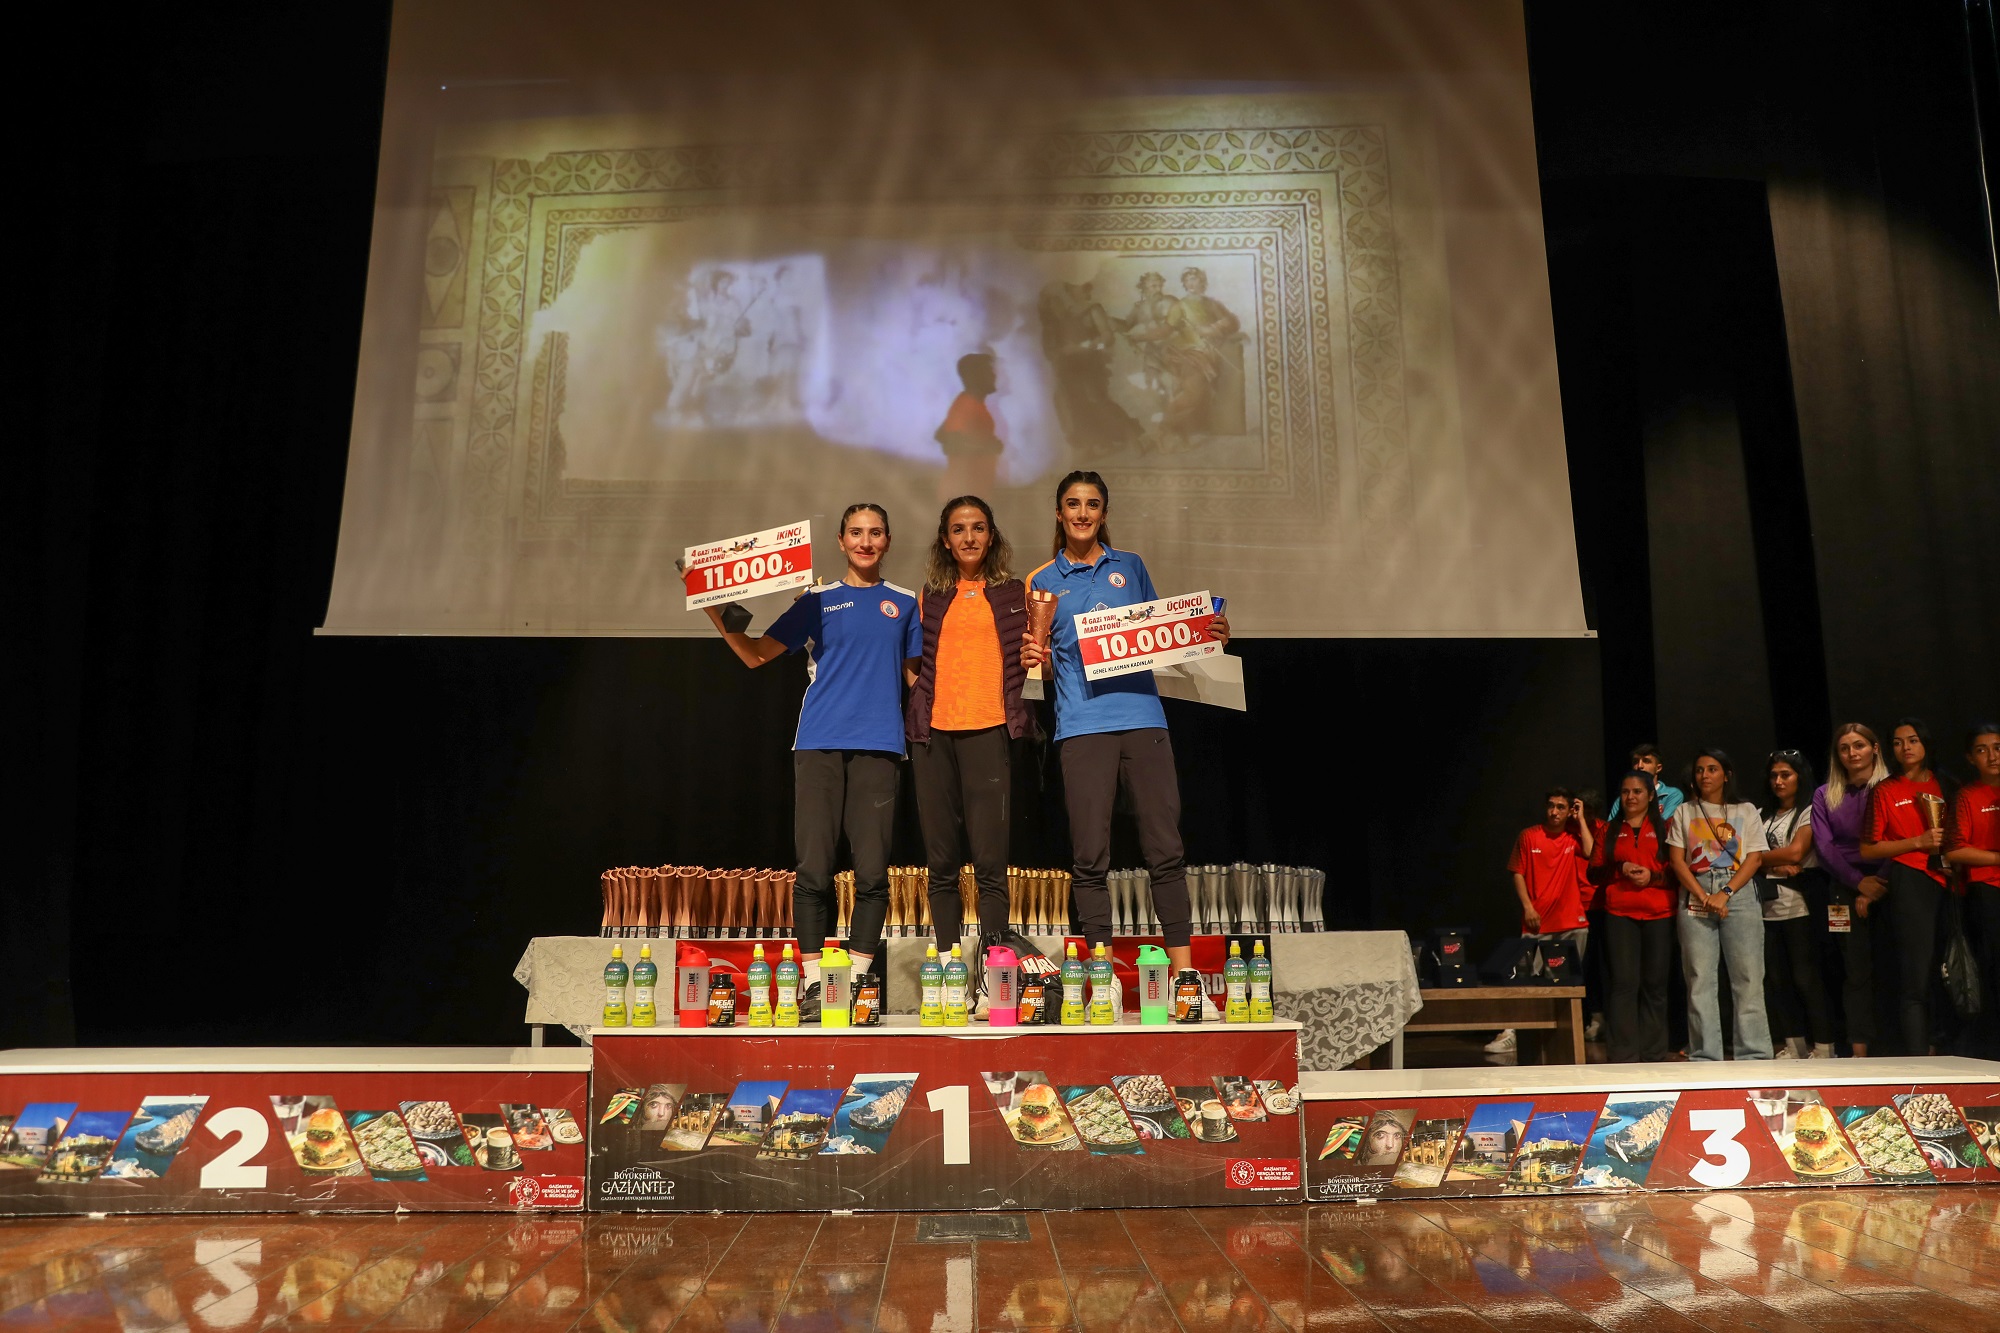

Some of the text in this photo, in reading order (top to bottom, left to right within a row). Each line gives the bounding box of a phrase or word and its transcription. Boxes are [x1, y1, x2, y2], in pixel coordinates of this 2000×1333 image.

[788, 538, 802, 546] 21K
[691, 549, 696, 558] 4
[710, 546, 723, 554] YARI
[692, 554, 726, 566] MARATONU
[706, 594, 726, 602] KLASMAN
[727, 588, 748, 598] KADINLAR
[824, 601, 854, 613] macron
[1166, 595, 1202, 612] ÜÇÜNCÜ
[1190, 608, 1204, 617] 21K
[1082, 617, 1087, 625] 4
[1084, 622, 1121, 634] MARATONU
[1108, 664, 1130, 672] KLASMAN
[1131, 659, 1154, 669] KADINLAR
[926, 1085, 970, 1165] 1
[200, 1106, 269, 1188] 2
[1688, 1108, 1752, 1188] 3
[601, 1180, 675, 1195] GAZİANTEP
